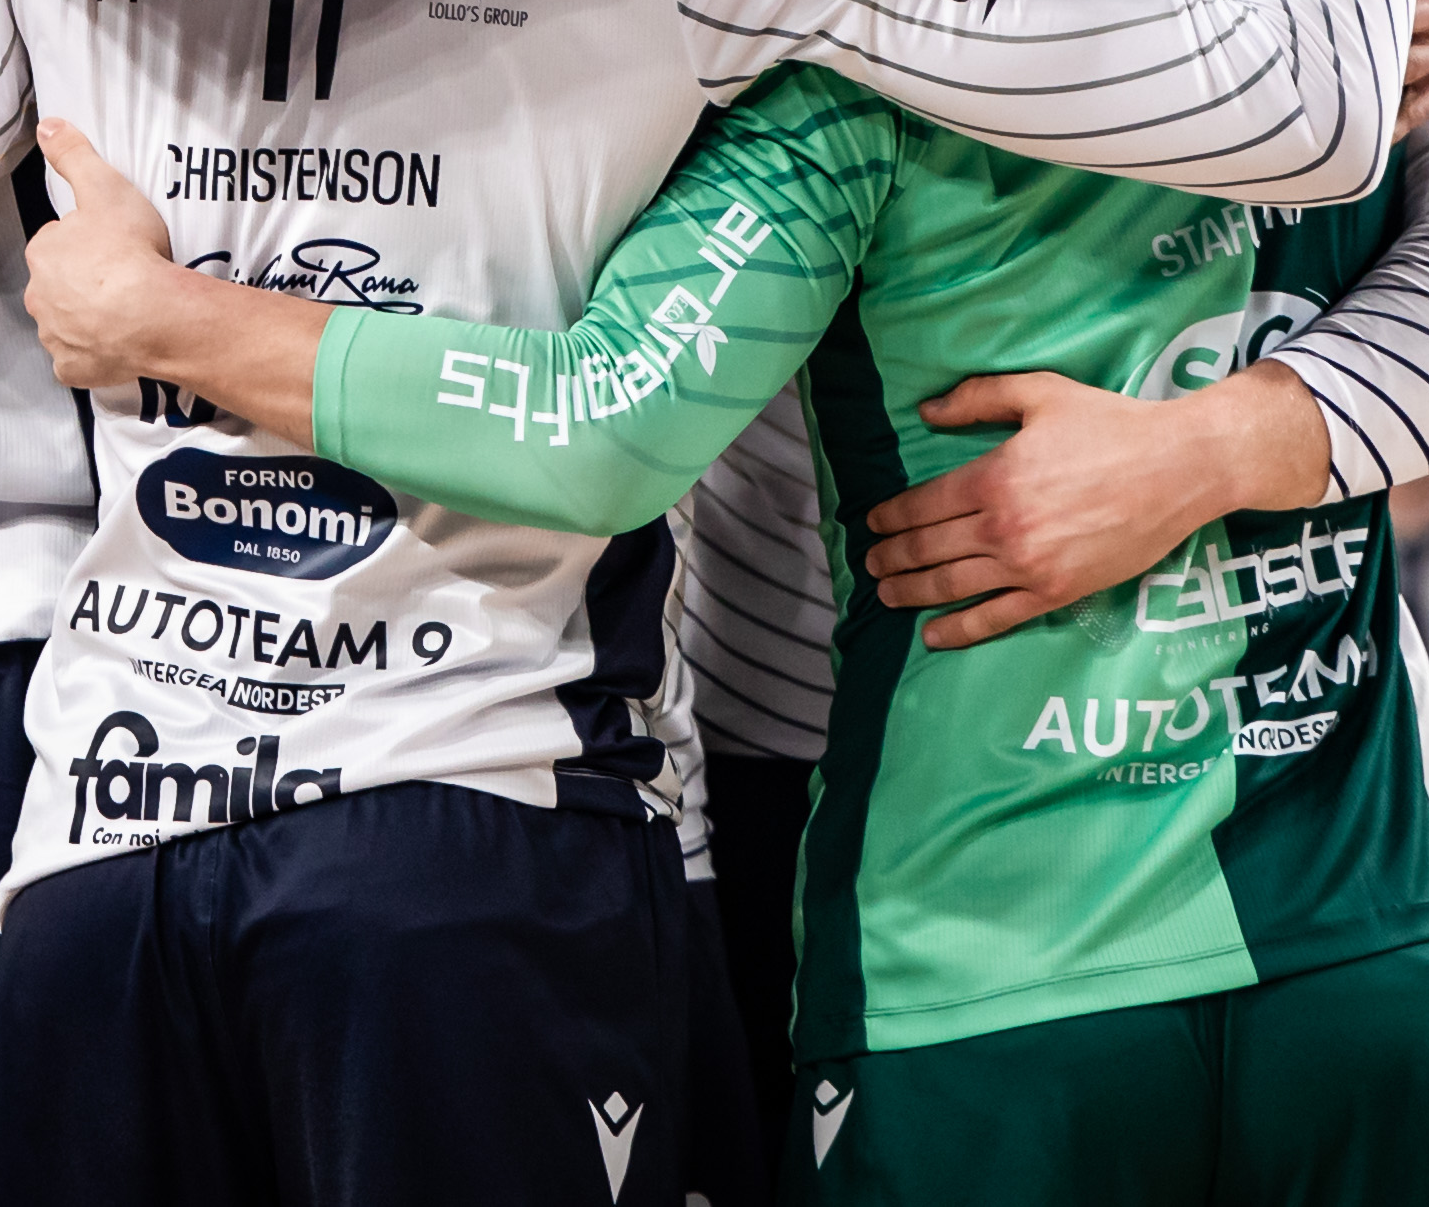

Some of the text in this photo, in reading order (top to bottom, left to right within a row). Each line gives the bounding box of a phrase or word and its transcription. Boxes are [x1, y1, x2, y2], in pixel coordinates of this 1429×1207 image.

[428, 1, 529, 28] LOLLO'S GROUP
[166, 143, 441, 208] CHRISTENSON
[291, 237, 424, 315] Rana
[225, 469, 314, 490] FORNO
[164, 480, 373, 547] Bonomi
[234, 540, 301, 564] DAL 1850
[70, 579, 453, 671] AUTOTEAM 9
[232, 681, 342, 712] NORDEST
[69, 710, 343, 845] famila
[93, 827, 123, 846] Con
